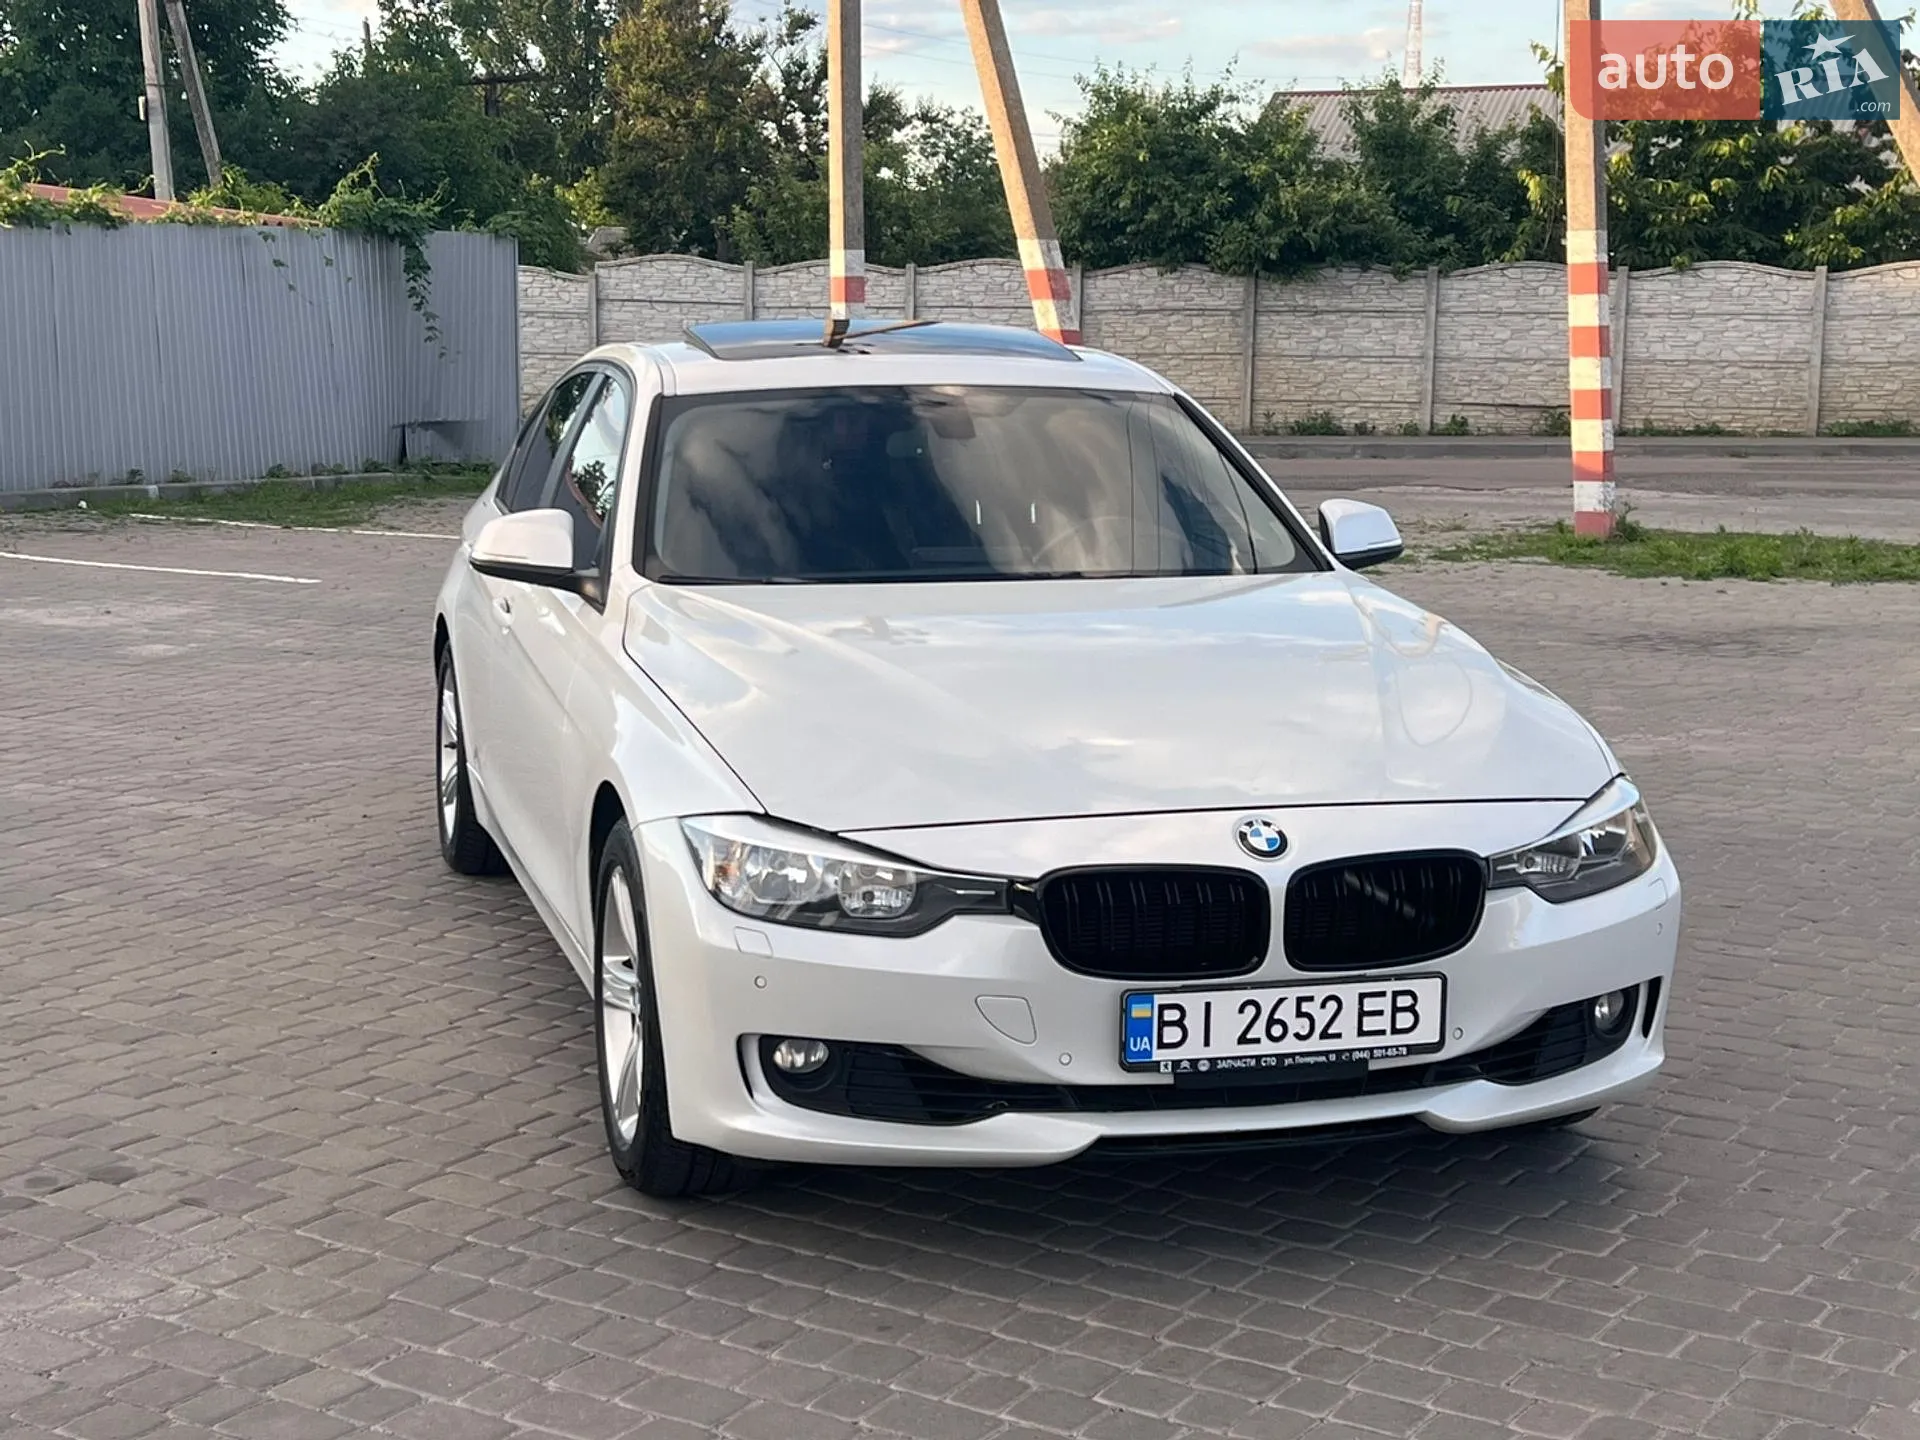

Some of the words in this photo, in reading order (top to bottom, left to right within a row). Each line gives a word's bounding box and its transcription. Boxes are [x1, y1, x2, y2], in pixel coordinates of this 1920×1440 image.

[1237, 994, 1344, 1046] 2652
[1357, 989, 1420, 1037] EB
[1130, 1037, 1151, 1052] UA
